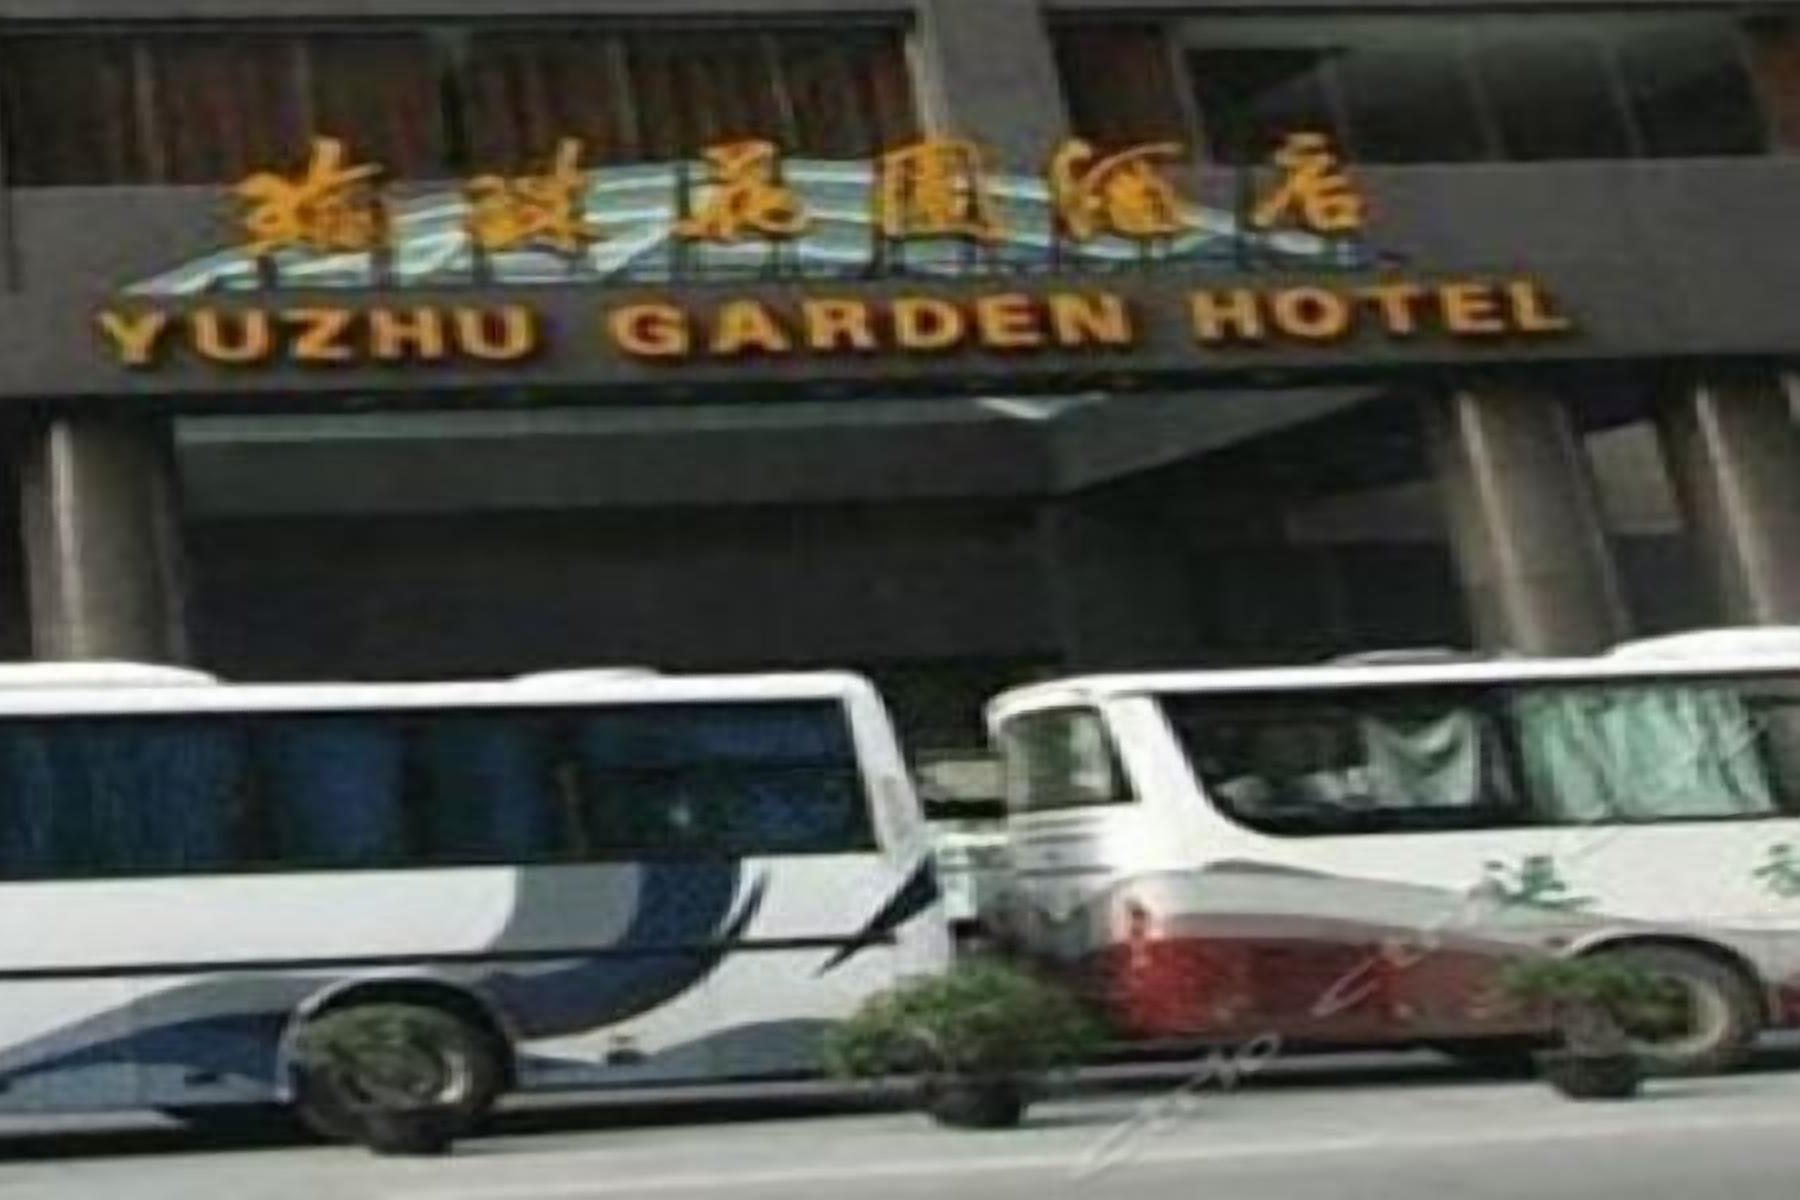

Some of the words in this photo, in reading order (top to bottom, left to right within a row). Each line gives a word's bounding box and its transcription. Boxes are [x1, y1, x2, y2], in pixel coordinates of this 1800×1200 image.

[98, 303, 536, 365] YUZHU
[611, 293, 1135, 358] GARDEN
[1191, 280, 1572, 342] HOTEL
